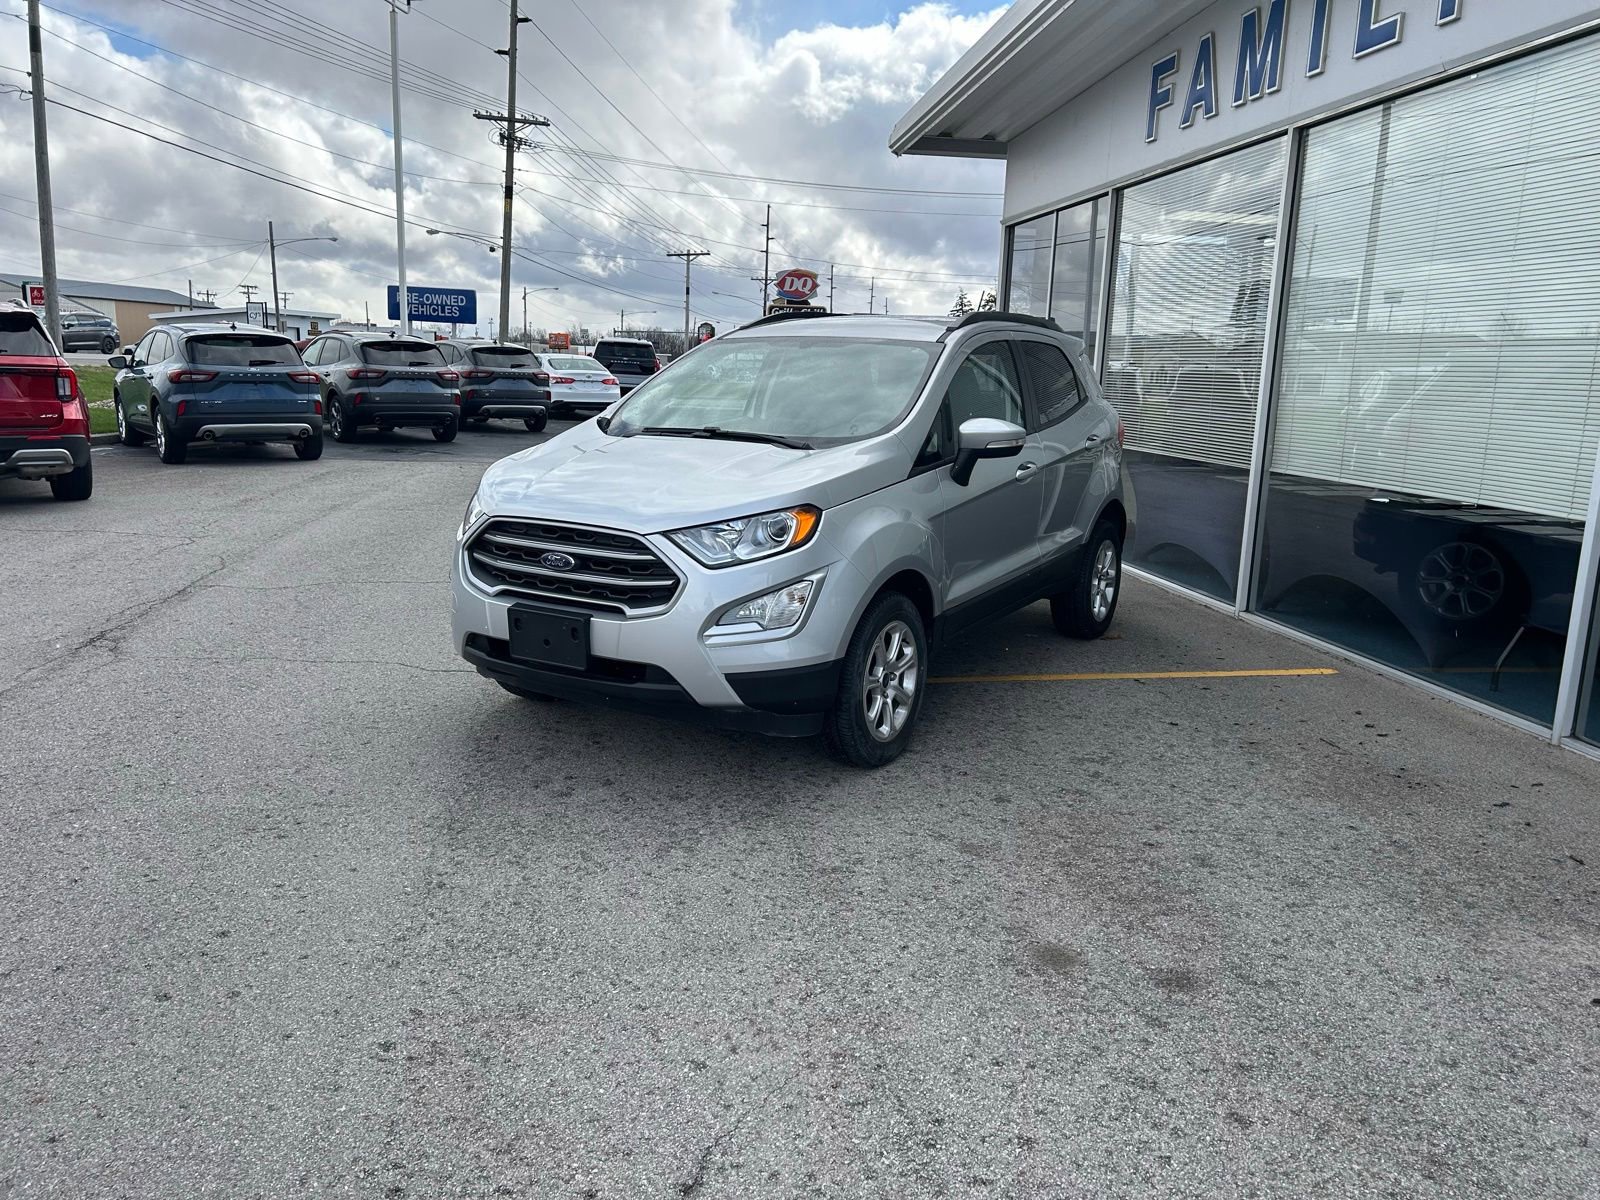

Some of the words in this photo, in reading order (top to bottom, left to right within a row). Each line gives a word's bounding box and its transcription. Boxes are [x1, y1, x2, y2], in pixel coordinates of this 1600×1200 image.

[1145, 0, 1461, 143] FAMIL
[783, 276, 812, 294] DQ
[545, 554, 566, 567] Ford
